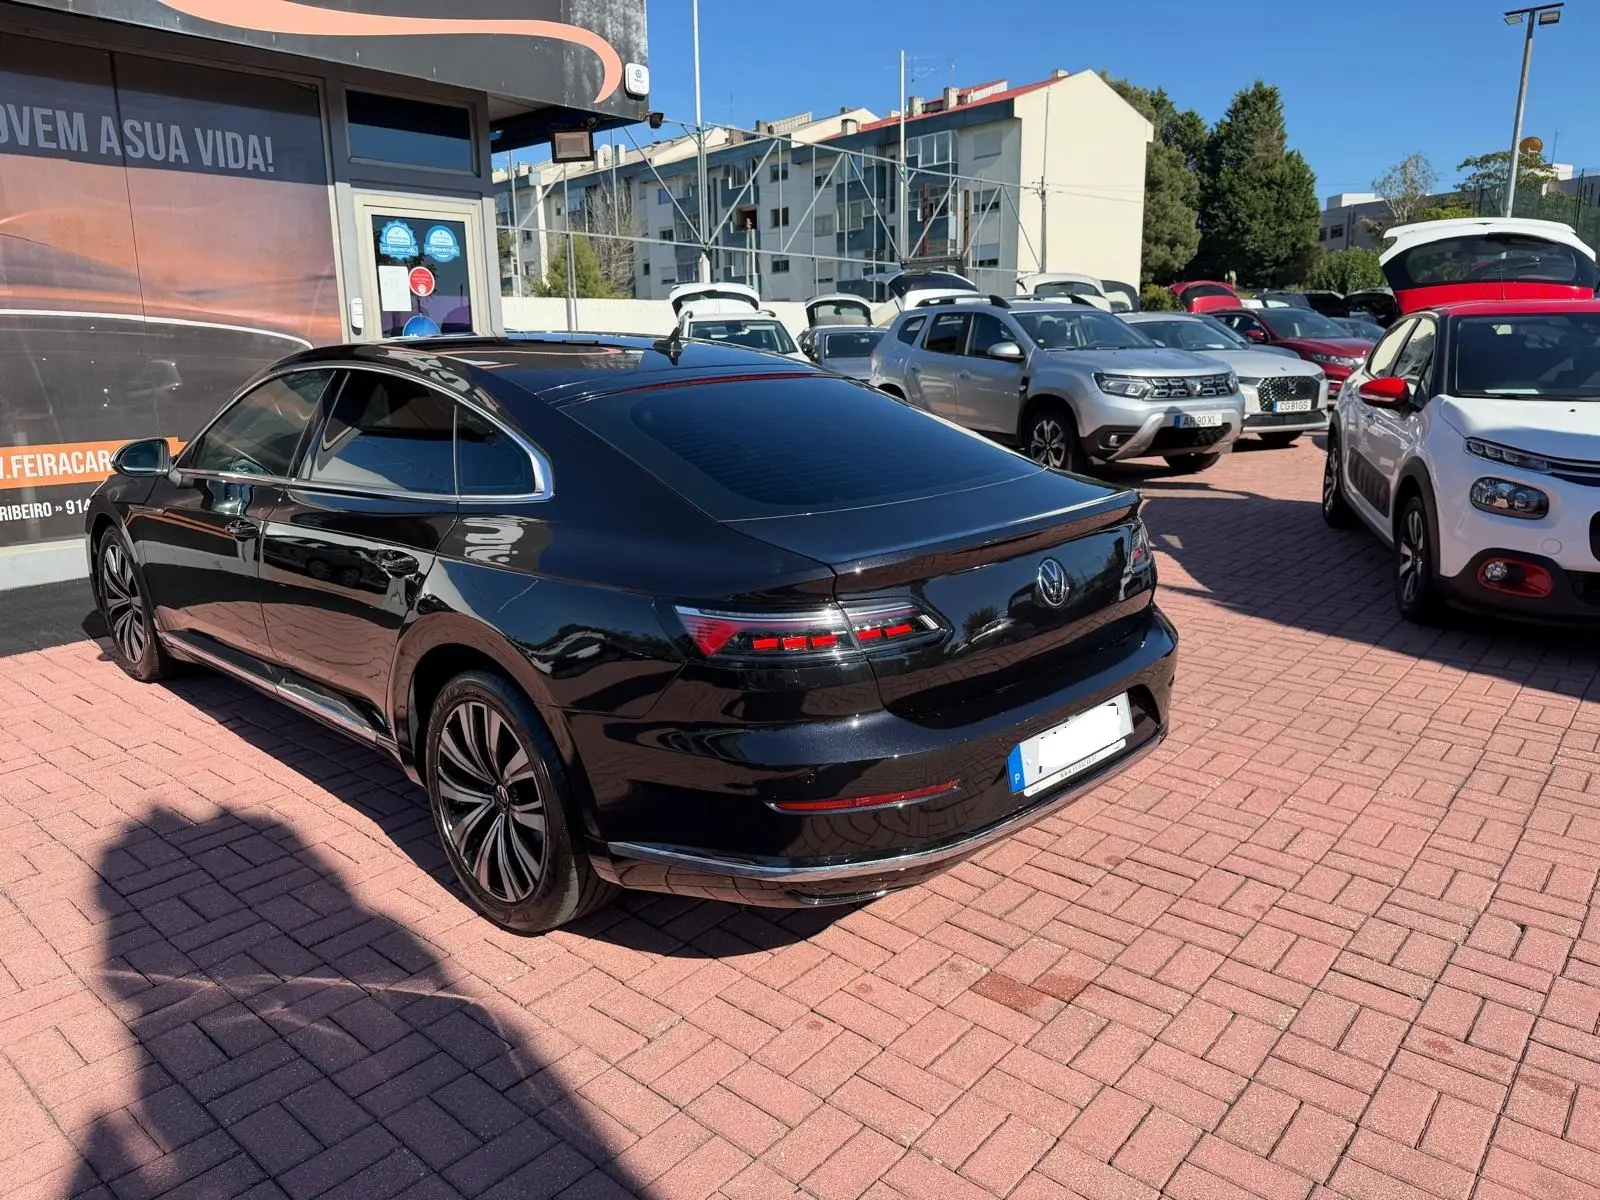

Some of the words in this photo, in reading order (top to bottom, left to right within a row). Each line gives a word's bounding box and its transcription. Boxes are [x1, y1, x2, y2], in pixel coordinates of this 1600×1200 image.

[194, 127, 274, 173] VIDA!
[0, 449, 112, 480] .FEIRACAR
[0, 501, 53, 522] RIBEIRO
